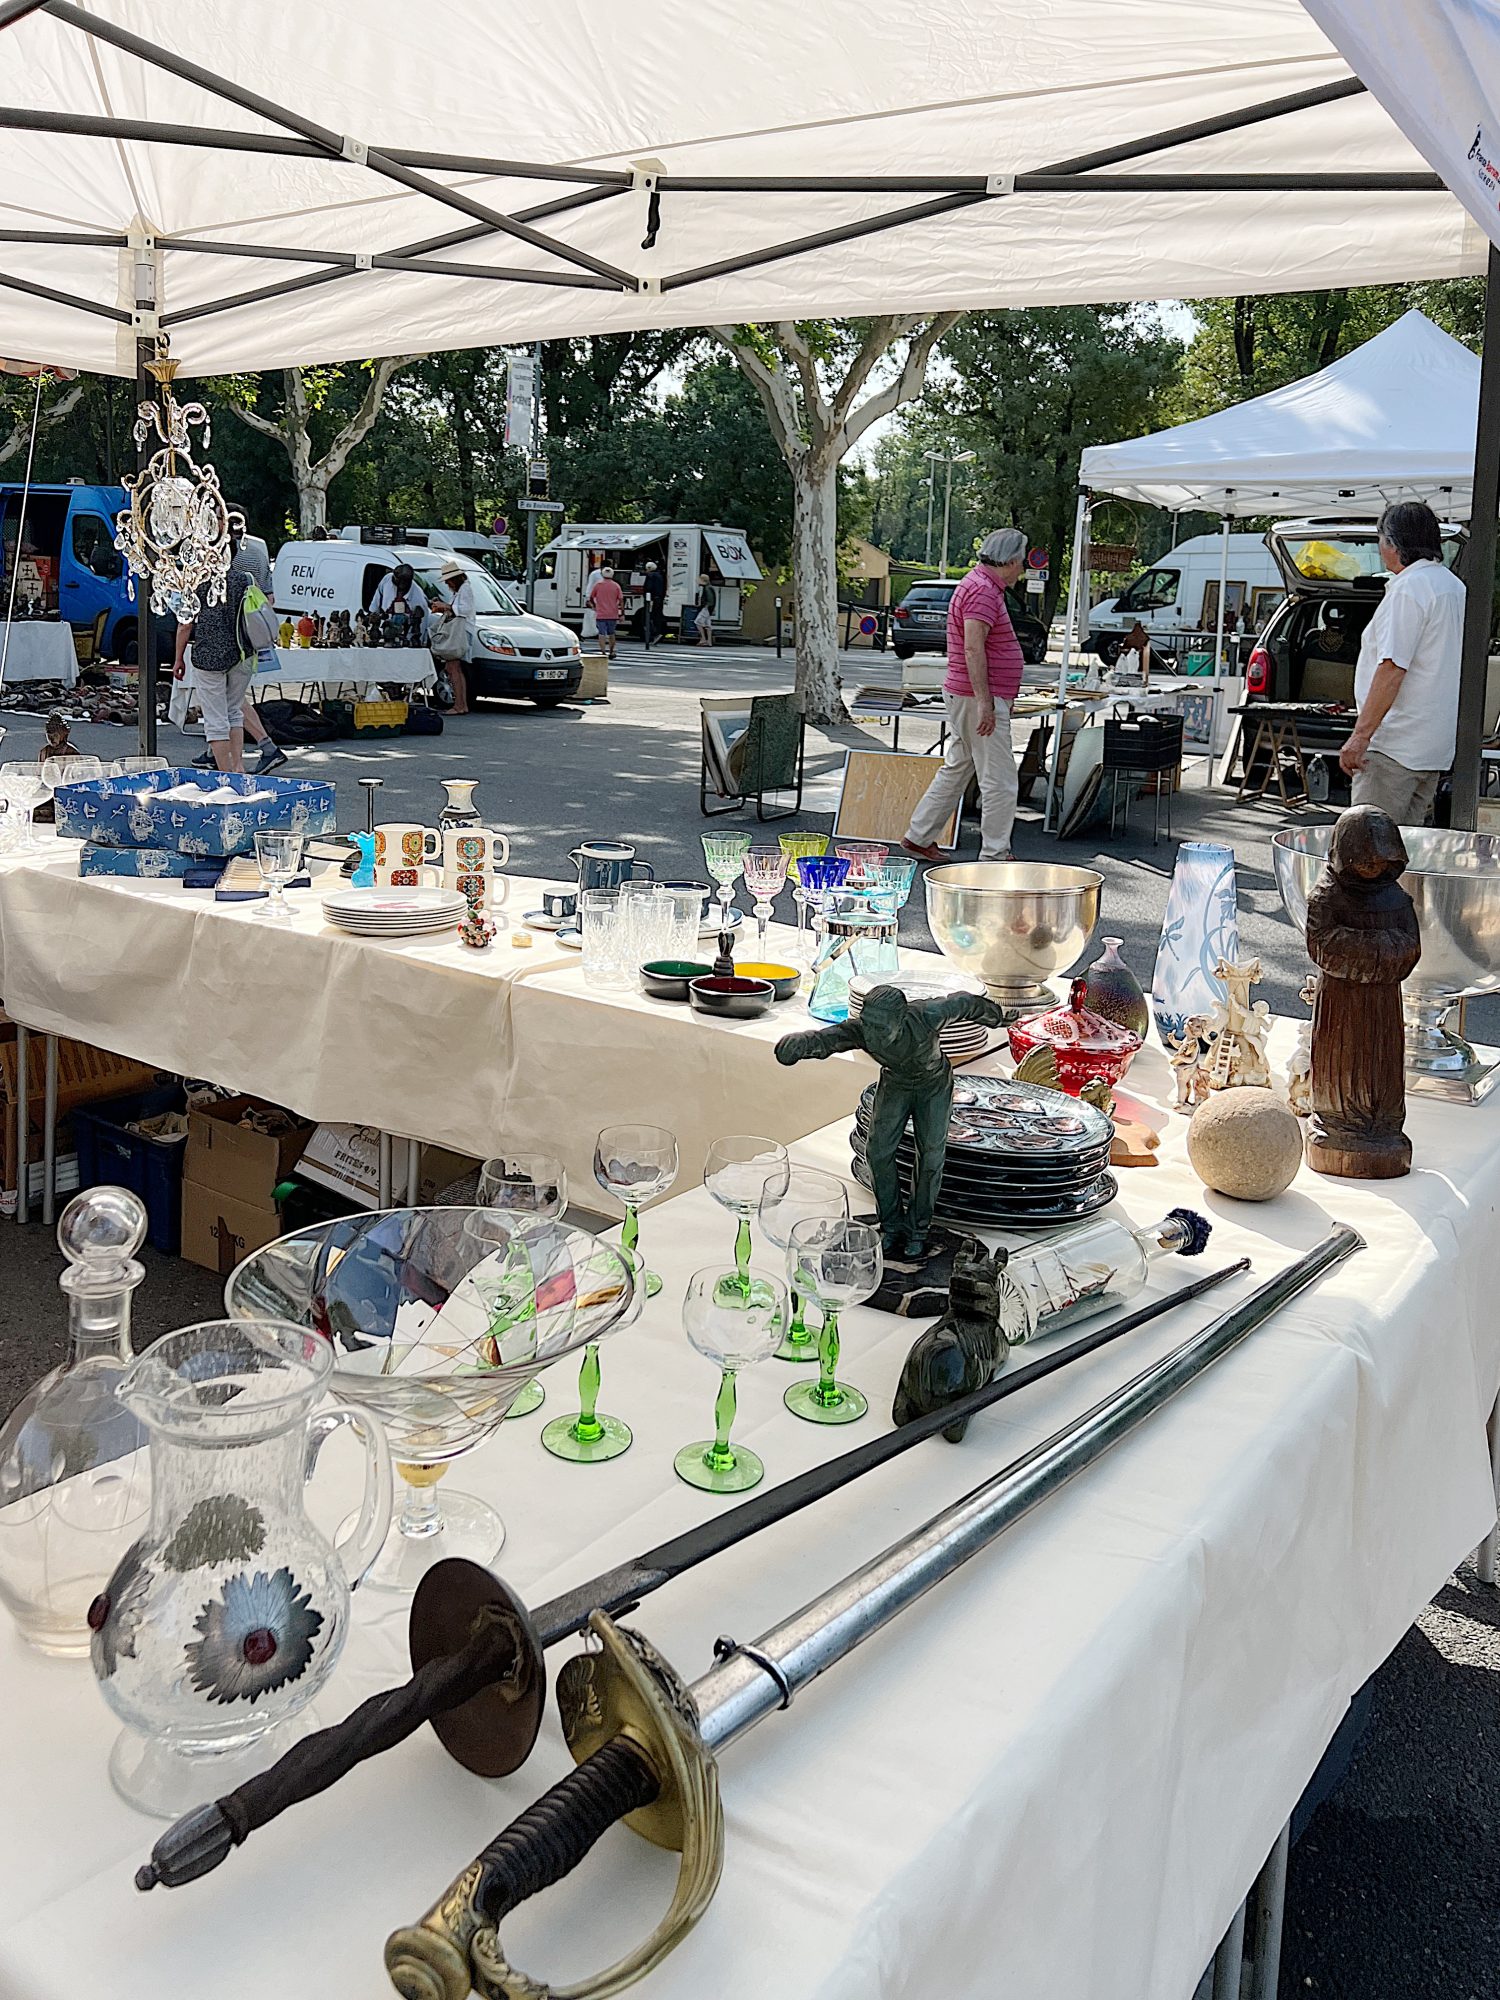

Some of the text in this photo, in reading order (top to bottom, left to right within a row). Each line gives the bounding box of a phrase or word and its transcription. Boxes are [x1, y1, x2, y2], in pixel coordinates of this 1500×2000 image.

[716, 544, 747, 561] BOX
[291, 564, 315, 578] REN
[291, 583, 335, 599] service
[334, 1150, 365, 1169] FRITES
